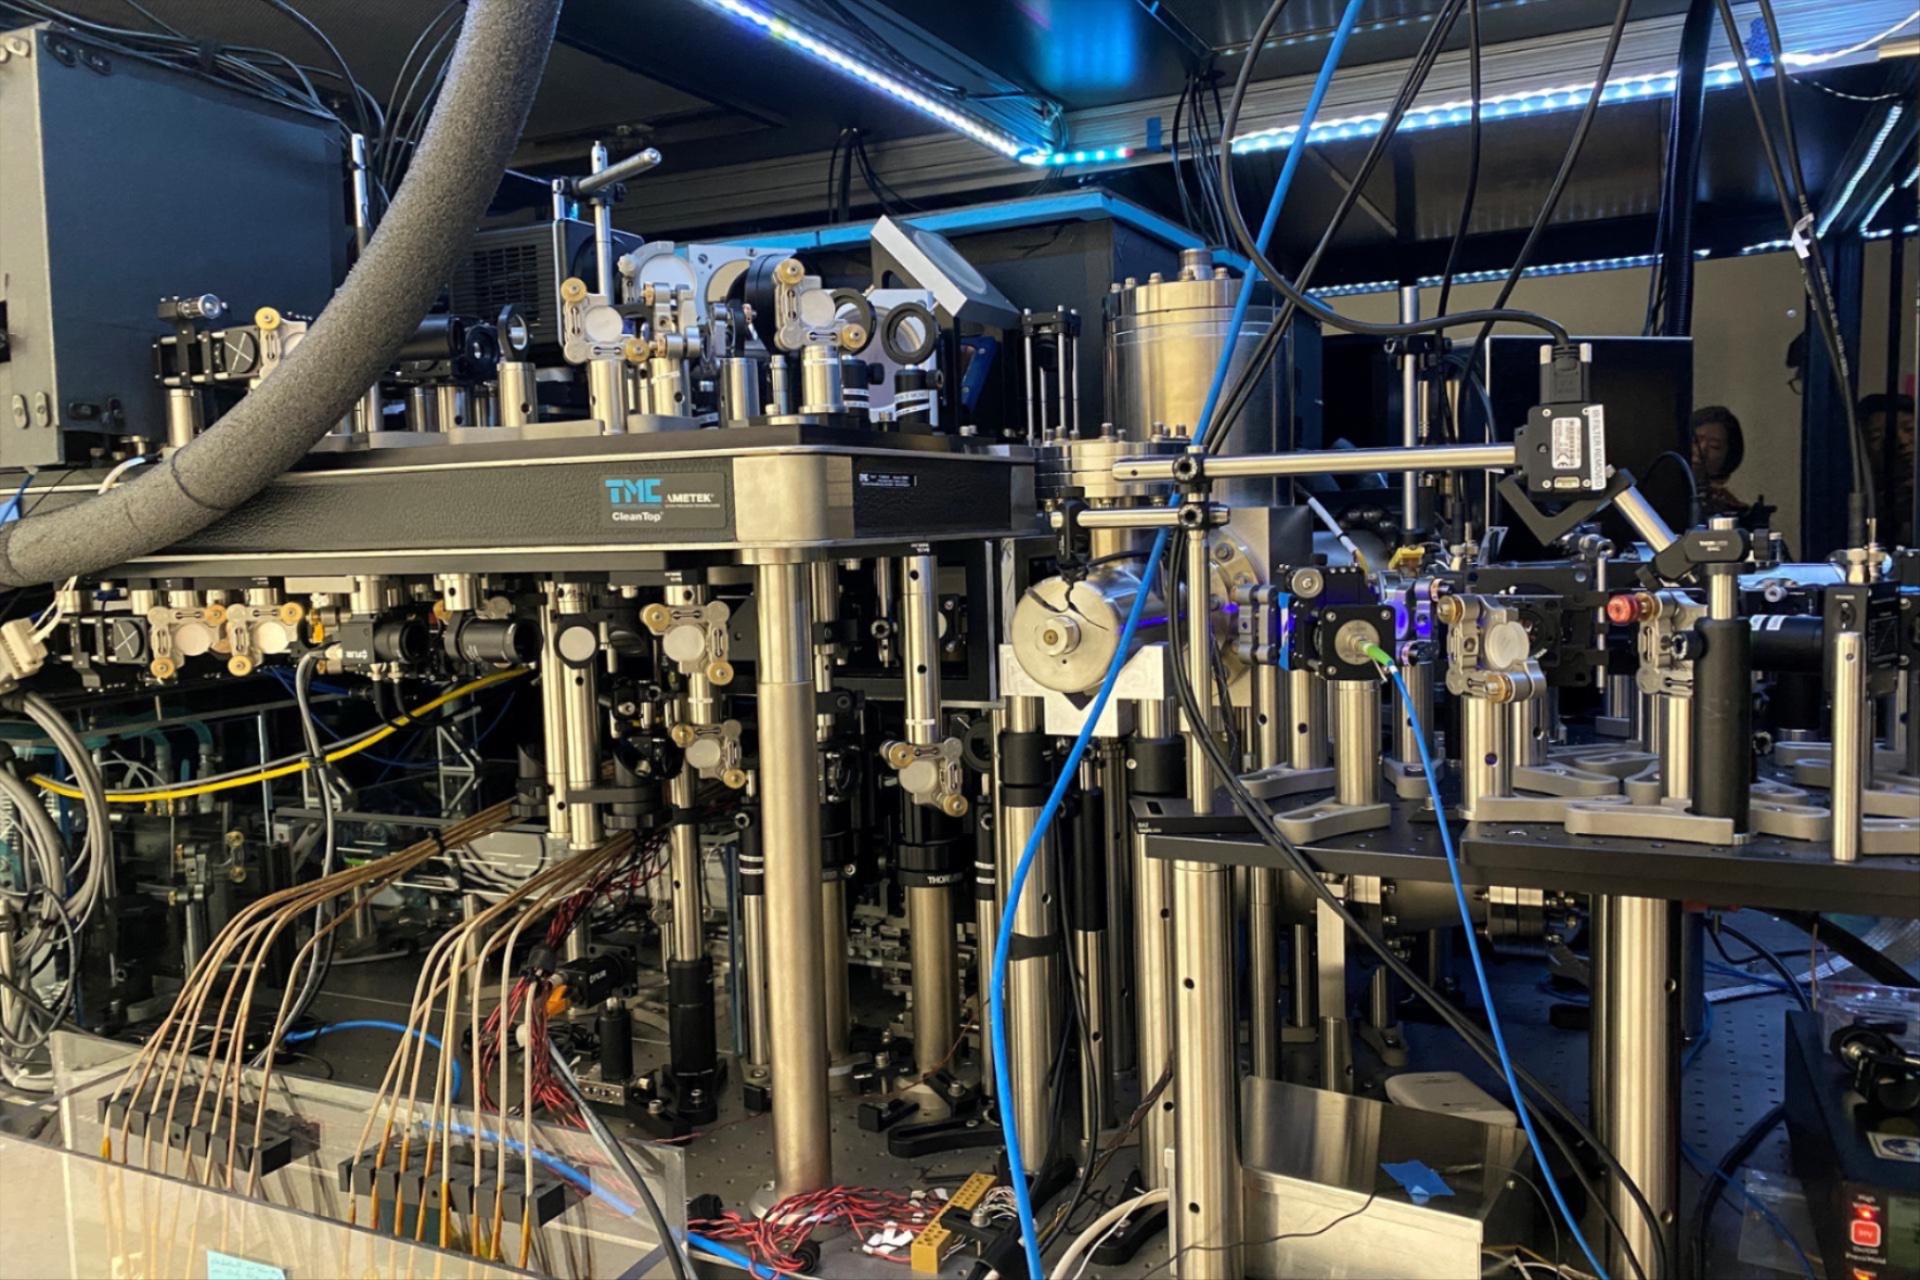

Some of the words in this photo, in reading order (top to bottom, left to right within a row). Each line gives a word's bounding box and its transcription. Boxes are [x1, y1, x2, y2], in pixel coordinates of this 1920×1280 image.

[1592, 419, 1601, 446] FILTER
[1594, 448, 1604, 487] REMOVED
[605, 479, 662, 503] TMC
[667, 493, 712, 502] AMETEK
[612, 511, 661, 522] CleanTop
